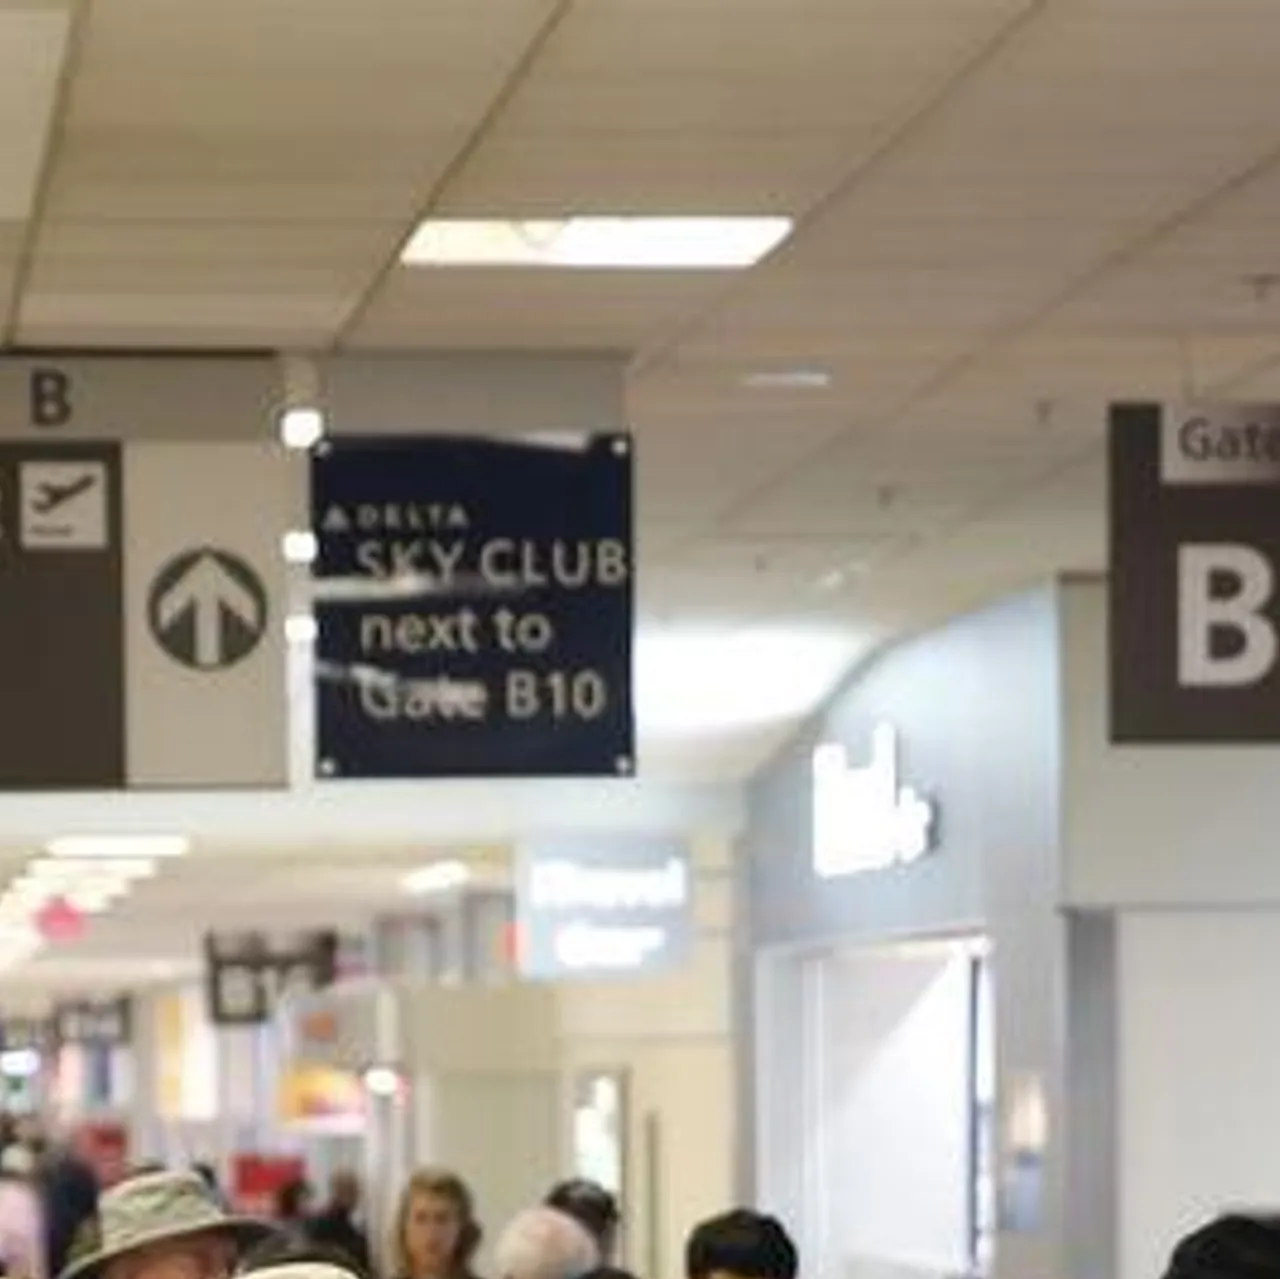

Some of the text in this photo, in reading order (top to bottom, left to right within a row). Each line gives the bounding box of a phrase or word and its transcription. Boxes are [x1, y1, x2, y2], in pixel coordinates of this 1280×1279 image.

[31, 368, 72, 426] B
[357, 504, 470, 528] DELTA
[357, 537, 628, 588] SKY CLUB
[361, 608, 552, 653] next to
[361, 669, 607, 720] Gate B10
